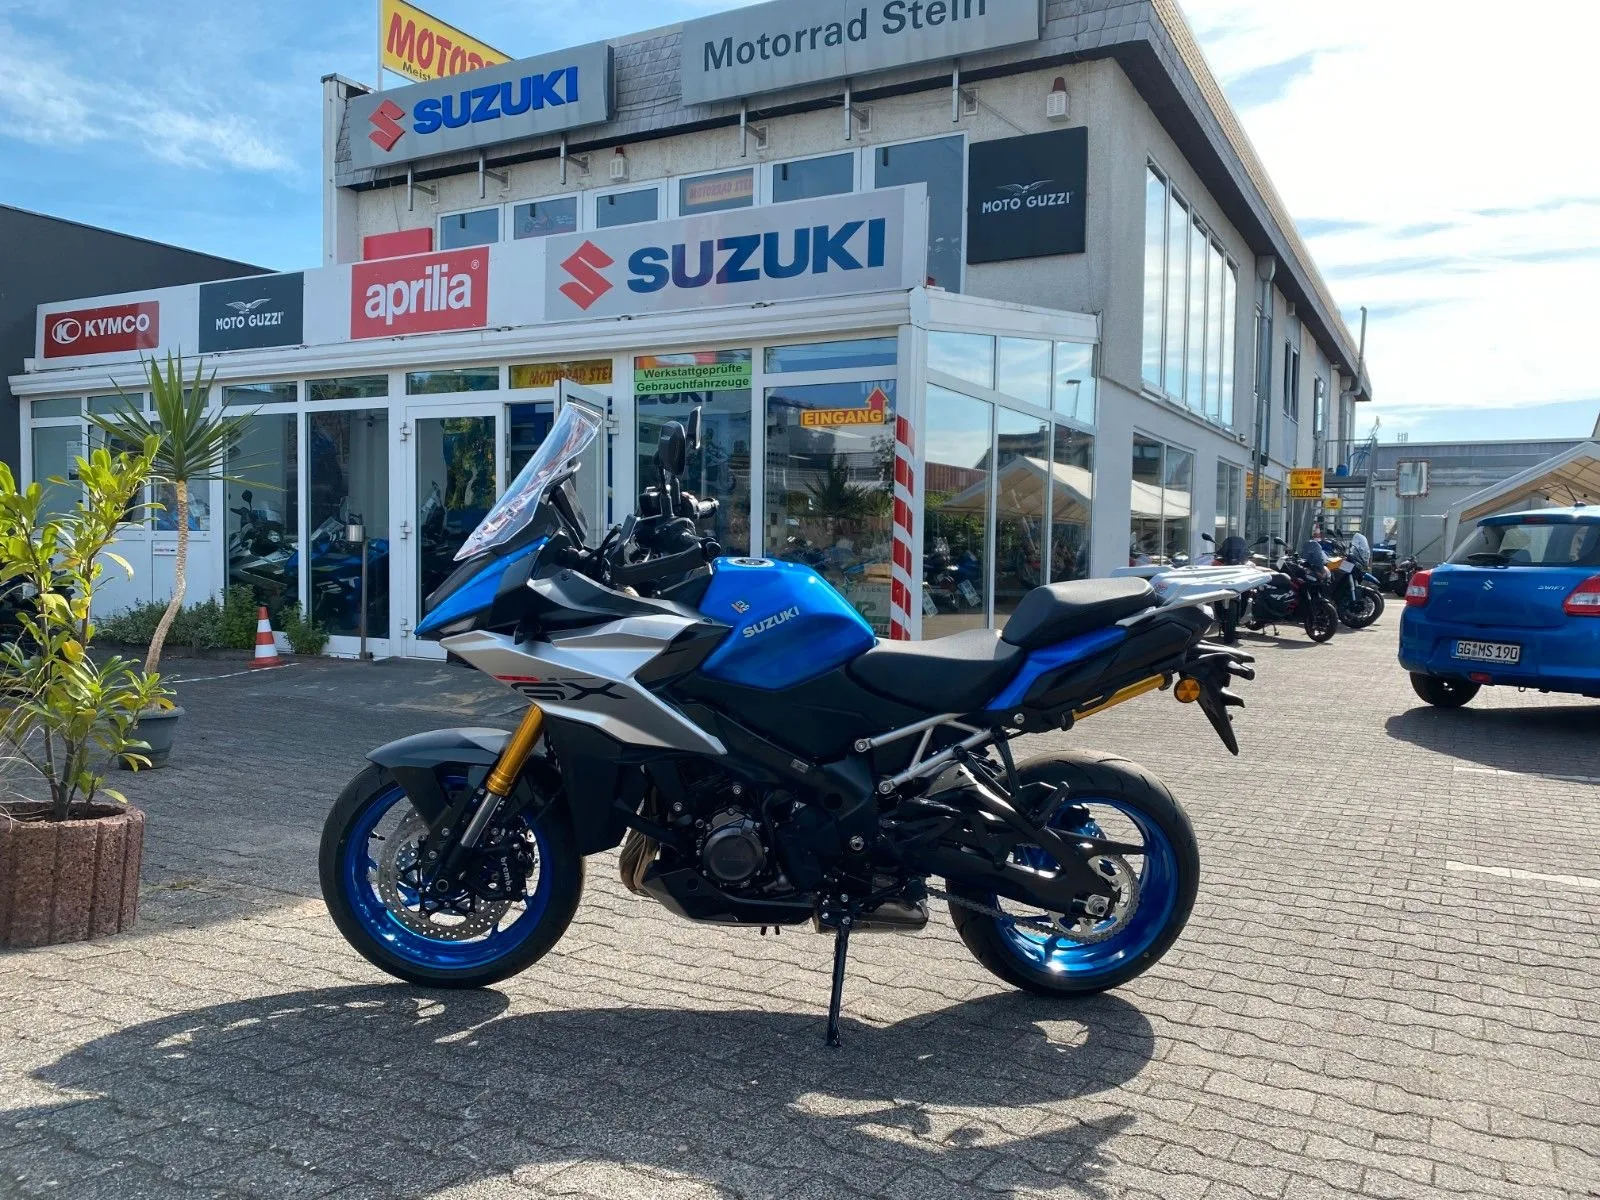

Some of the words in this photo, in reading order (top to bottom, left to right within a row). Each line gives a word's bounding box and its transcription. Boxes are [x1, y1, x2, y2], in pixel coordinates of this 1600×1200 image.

[386, 12, 497, 77] MOTO
[704, 7, 868, 72] Motorrad
[881, 0, 986, 35] Stein
[413, 66, 579, 134] SUZUKI
[982, 198, 1021, 213] MOTO
[1026, 192, 1070, 208] GUZZI
[627, 217, 886, 294] SUZUKI
[364, 263, 472, 325] aprilia
[84, 313, 150, 337] KYMCO
[215, 316, 245, 331] MOTO
[248, 311, 282, 327] GUZZI
[643, 364, 743, 378] Werkstattgeprüfte
[636, 378, 749, 392] Gebrauchtfahrzeuge
[804, 409, 882, 425] EINGANG
[1291, 489, 1321, 497] EINGANG
[742, 605, 800, 638] SUZUKI
[1456, 642, 1471, 655] GG
[1477, 645, 1493, 658] MS
[1495, 647, 1518, 659] 190
[500, 856, 513, 892] brembo
